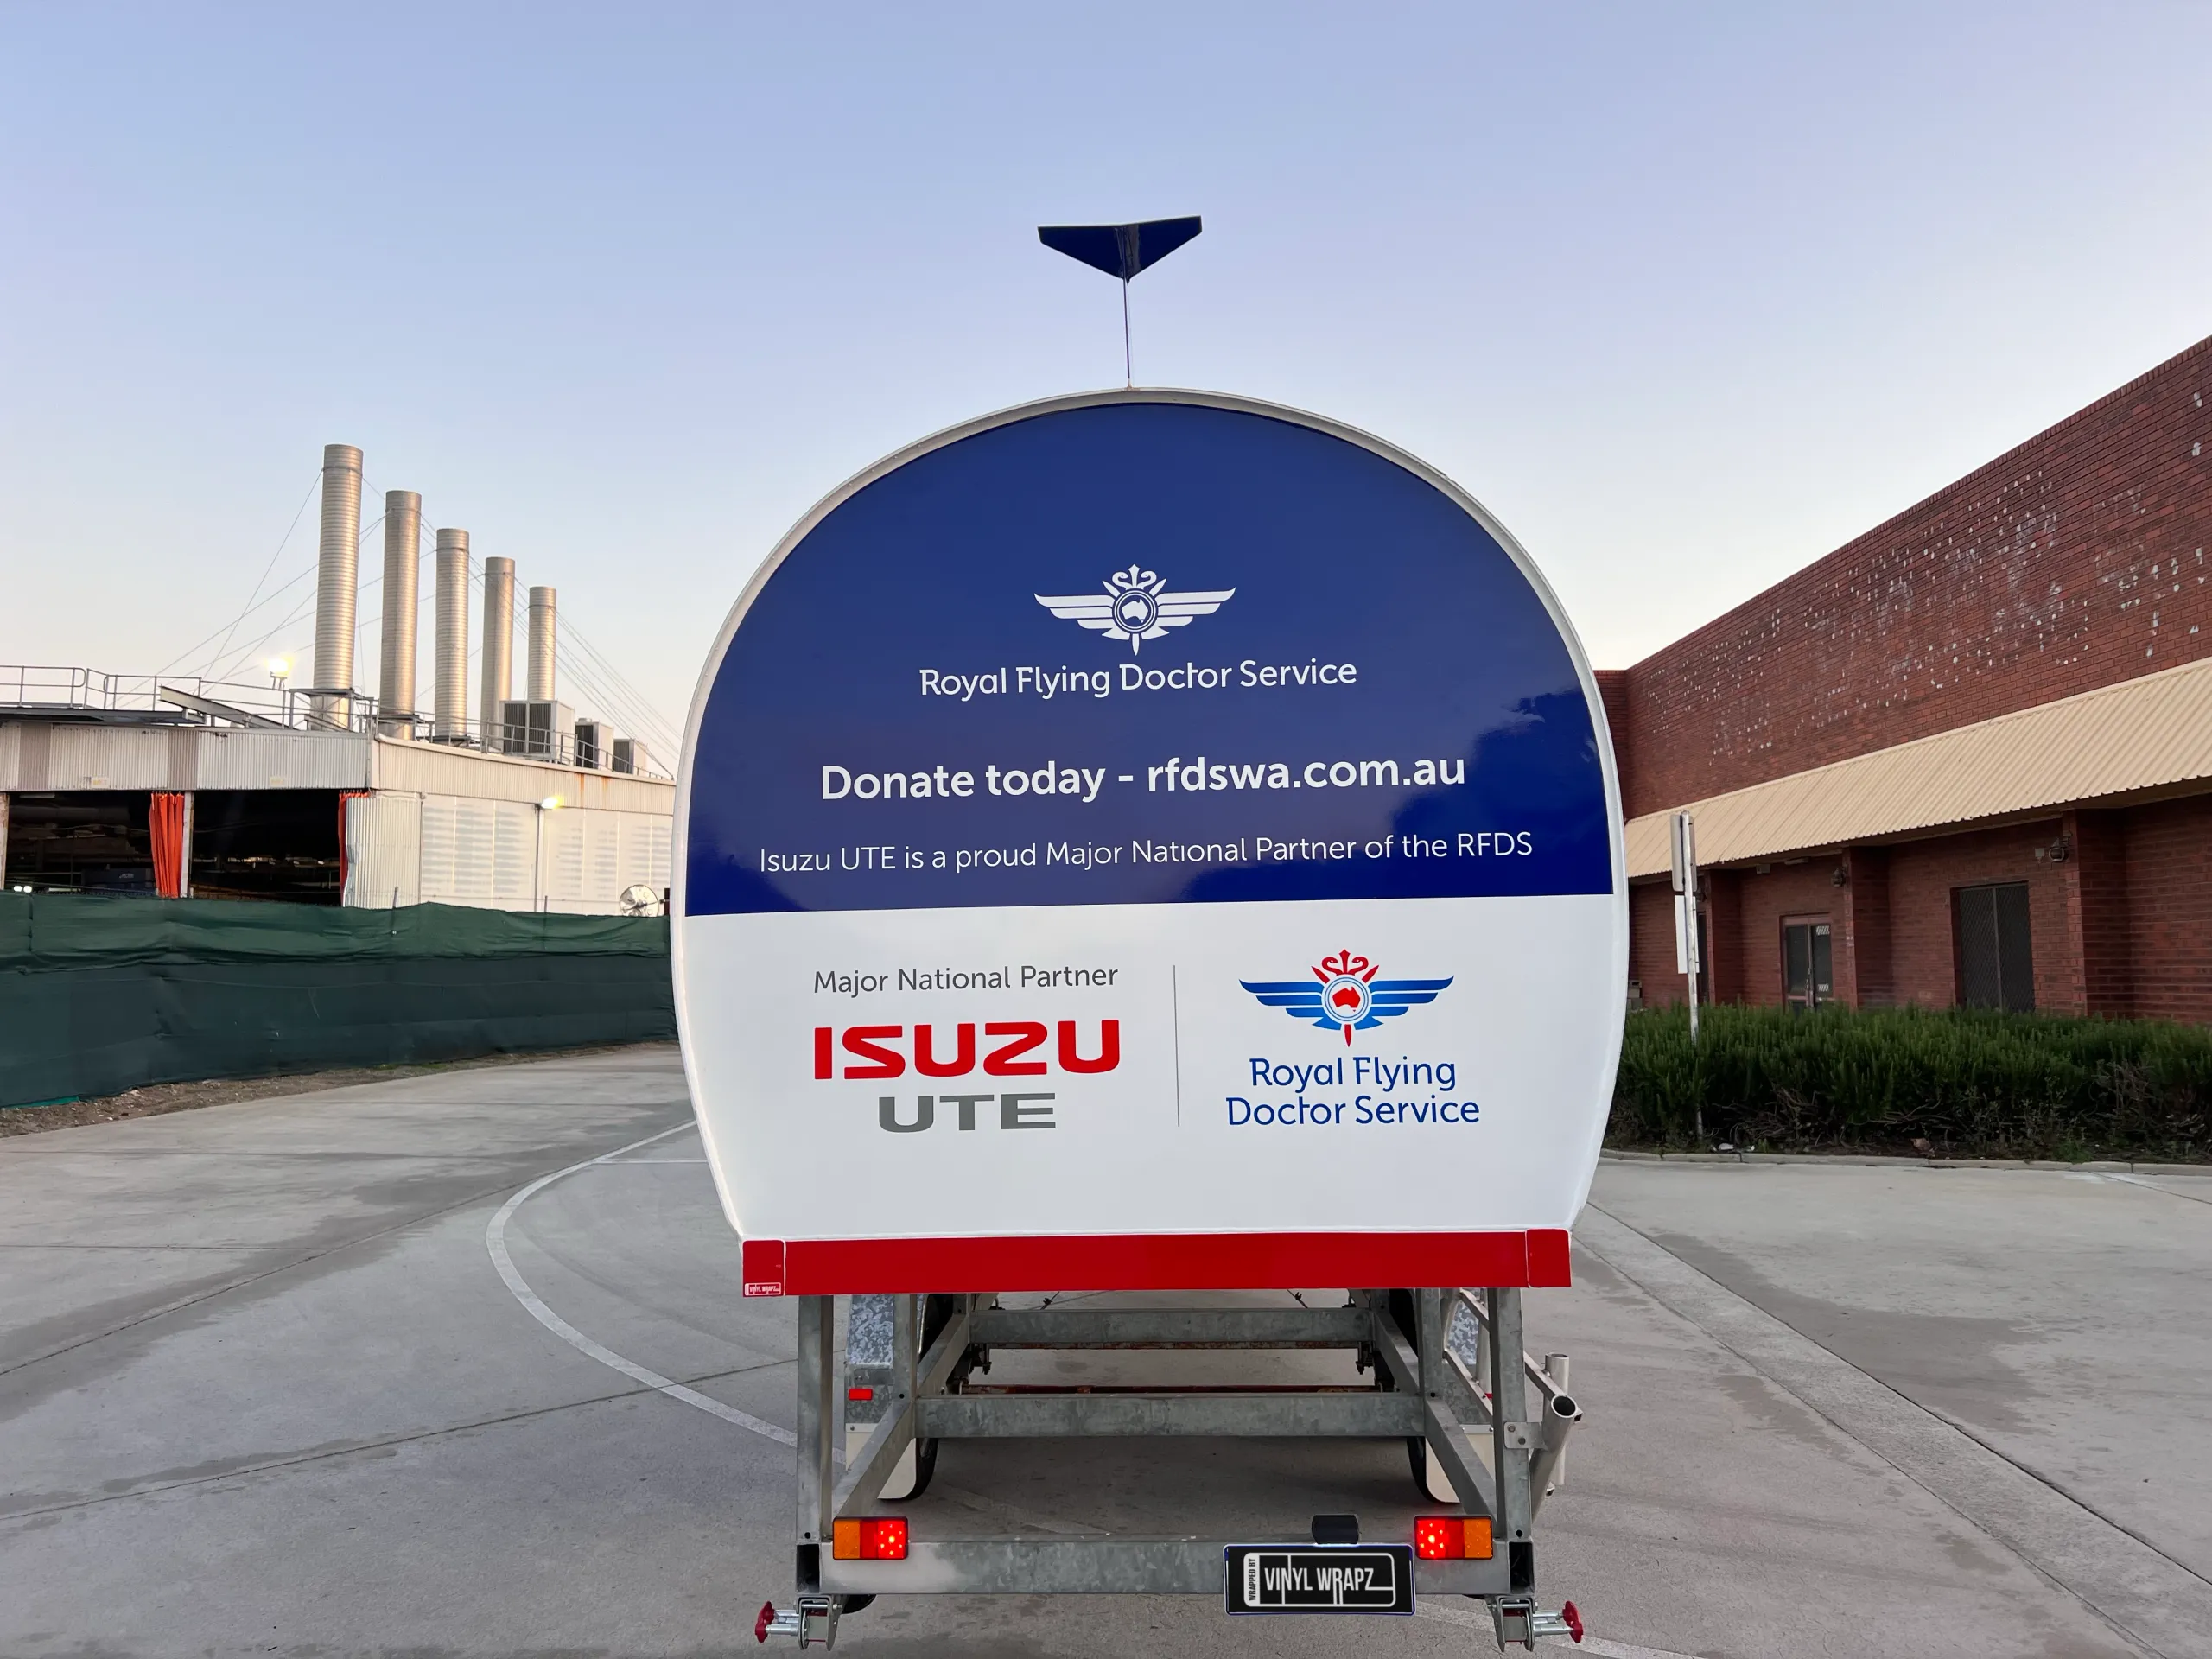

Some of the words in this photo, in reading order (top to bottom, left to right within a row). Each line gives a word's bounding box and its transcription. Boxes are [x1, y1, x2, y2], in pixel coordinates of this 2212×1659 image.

[919, 667, 1007, 702] Royal
[1016, 664, 1110, 700] Flying
[1119, 662, 1233, 690] Doctor
[1239, 659, 1357, 687] Service
[822, 766, 975, 800] Donate
[985, 760, 1106, 803] today
[1147, 756, 1465, 791] rfdswa.com.au
[760, 849, 830, 873] Isuzu
[841, 846, 896, 871] UTE
[905, 844, 925, 869] is
[931, 850, 946, 868] a
[956, 842, 1036, 874] proud
[1046, 841, 1123, 871] Major
[1131, 837, 1248, 863] National
[1256, 836, 1357, 861] Partner
[1364, 834, 1394, 860] of
[1401, 834, 1447, 858] the
[1458, 831, 1533, 857] RFDS
[814, 969, 889, 999] Major
[899, 965, 1011, 991] National
[1020, 965, 1119, 988] Partner
[814, 1019, 1121, 1080] ISUZU
[1249, 1057, 1344, 1094] Royal
[1352, 1056, 1456, 1092] Flying
[878, 1092, 1057, 1134] UTE
[1225, 1096, 1347, 1126] Doctor
[1354, 1094, 1480, 1125] Service
[1248, 1558, 1257, 1567] BY
[1264, 1567, 1313, 1591] VINYL
[1316, 1567, 1375, 1591] WRAPZ
[1248, 1568, 1257, 1601] WRAPPED
